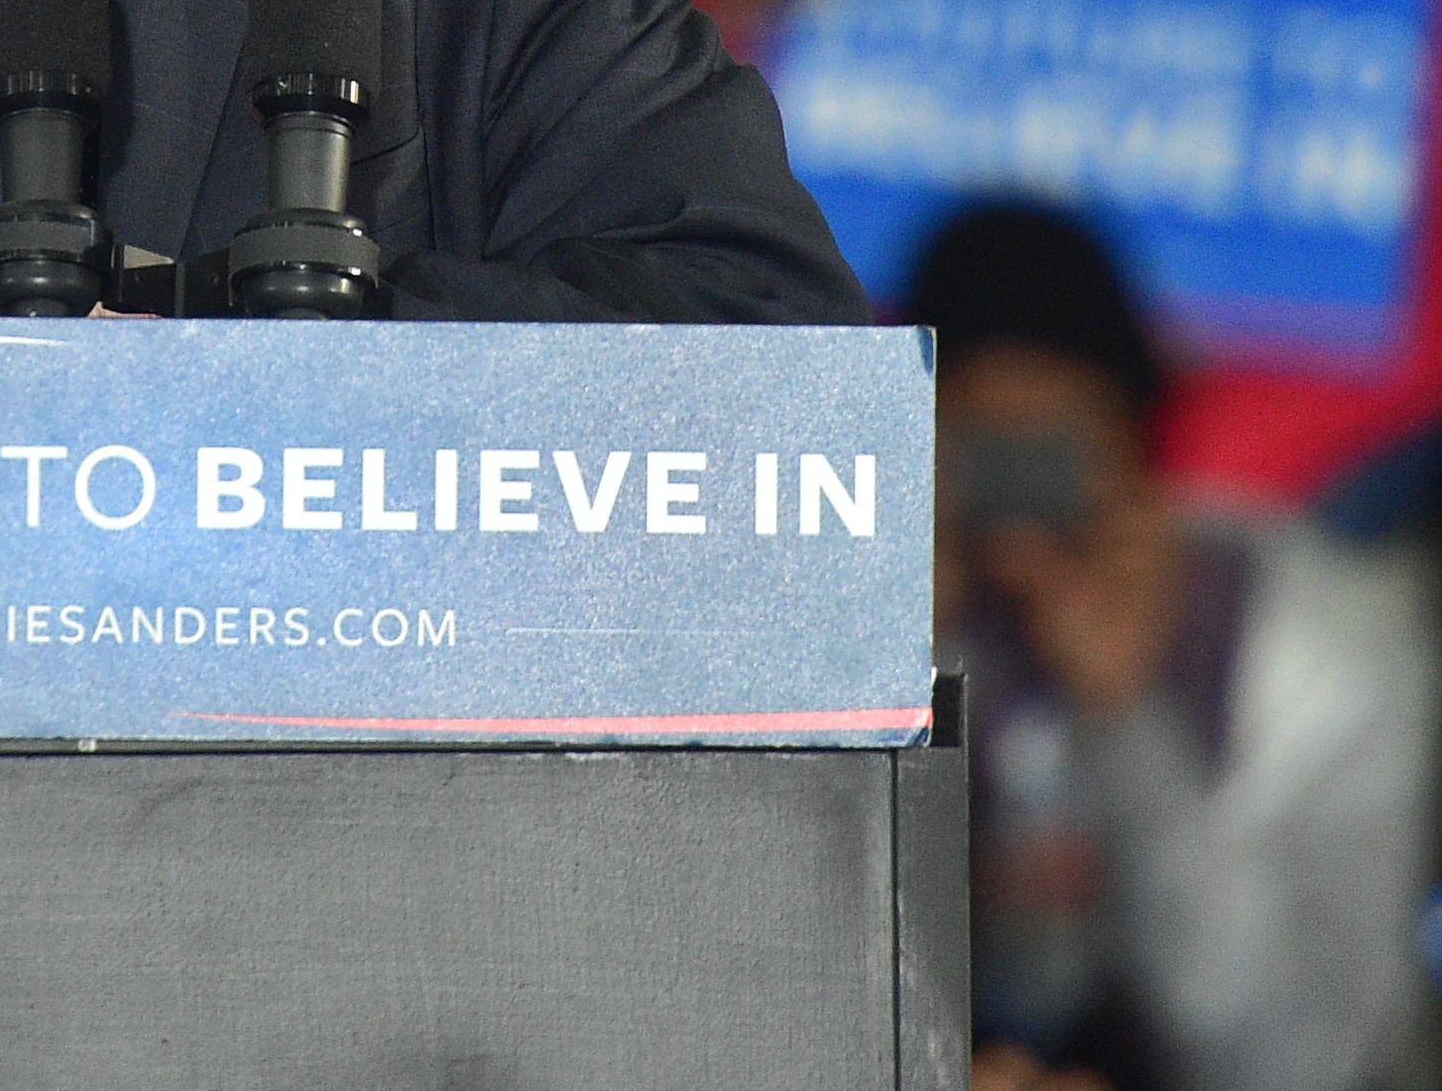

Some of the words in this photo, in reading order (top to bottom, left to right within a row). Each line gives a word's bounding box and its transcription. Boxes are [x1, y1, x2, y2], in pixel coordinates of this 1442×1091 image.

[0, 445, 157, 531] TO
[196, 447, 708, 535] BELIEVE
[754, 453, 877, 538] IN
